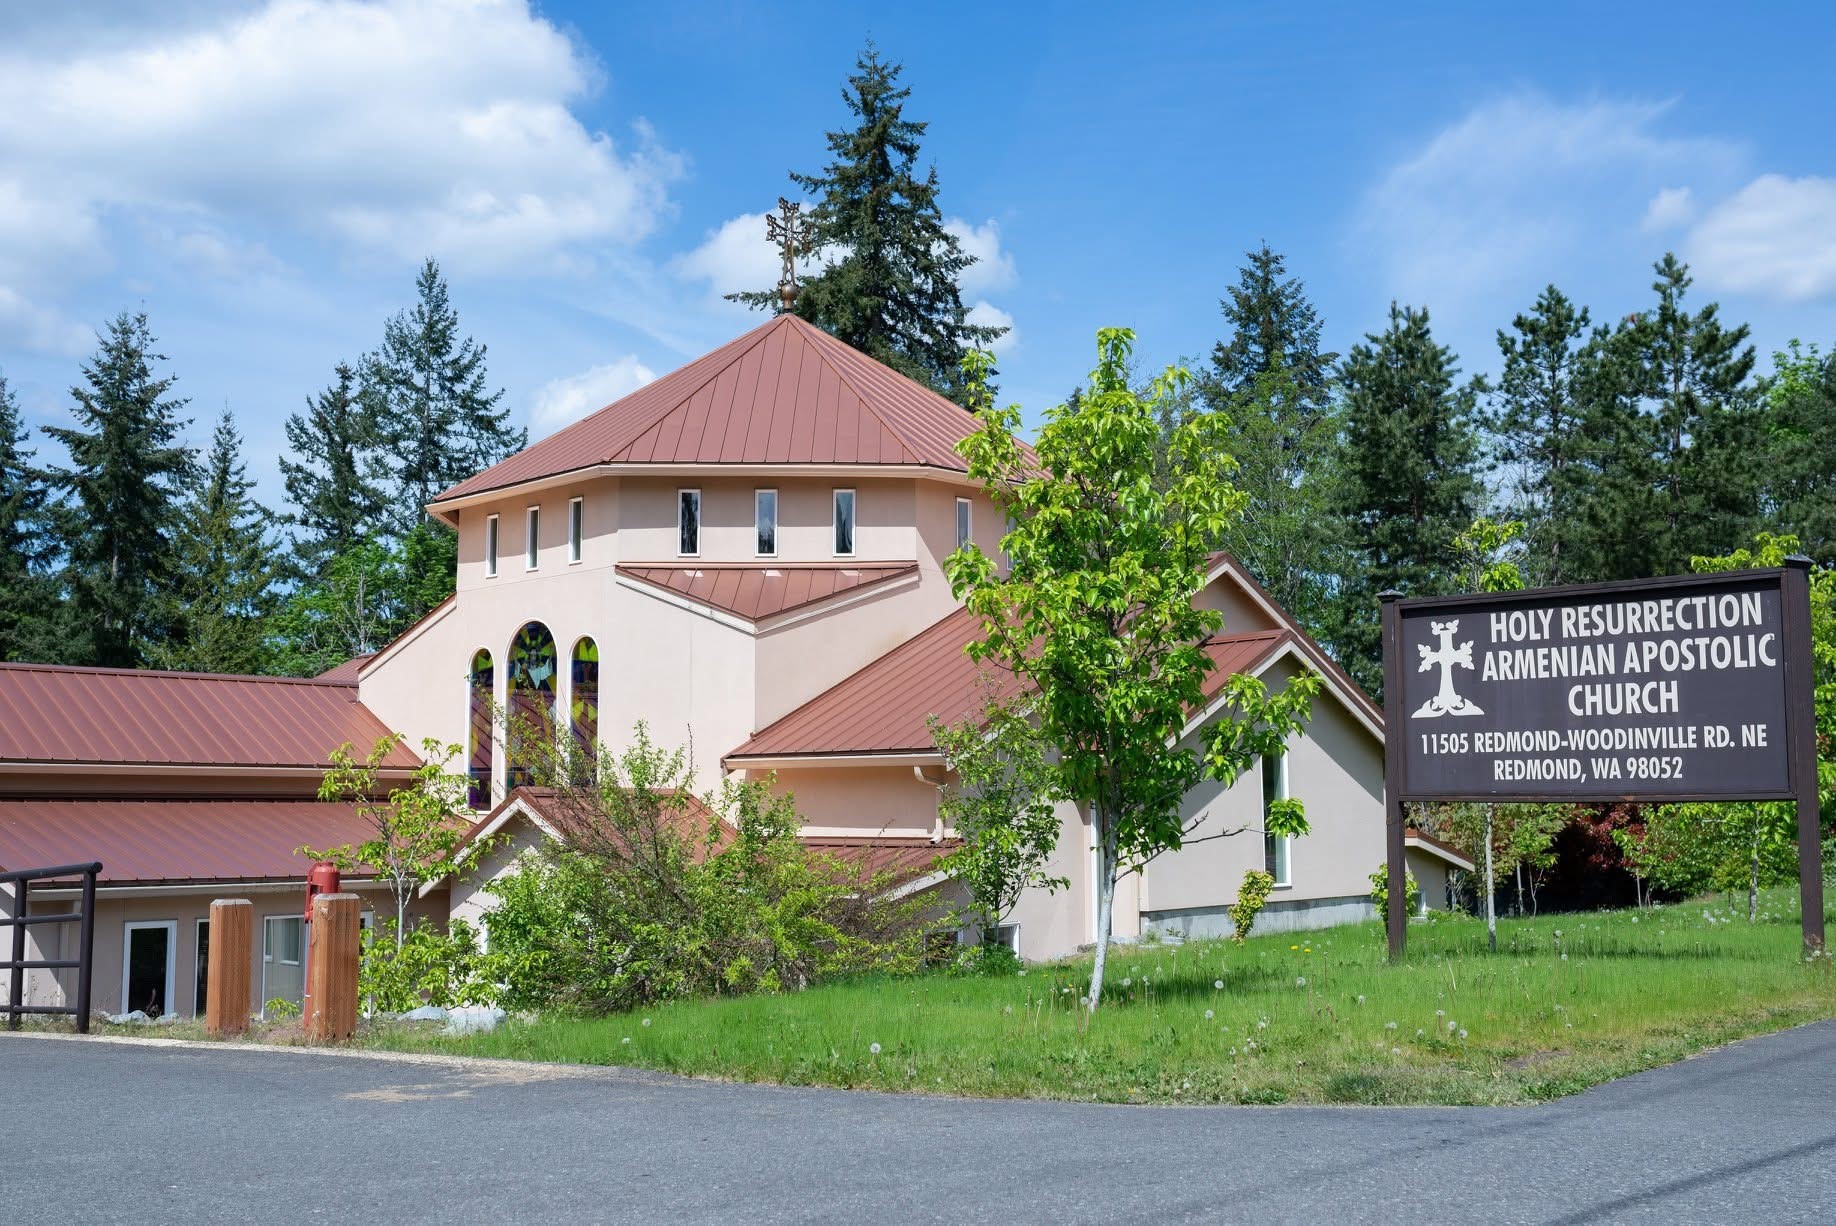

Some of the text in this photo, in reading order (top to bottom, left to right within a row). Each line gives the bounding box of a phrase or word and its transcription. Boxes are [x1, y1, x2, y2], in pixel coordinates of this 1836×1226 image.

[1490, 592, 1763, 643] HOLY RESURRECTION
[1481, 632, 1777, 682] ARMENIAN APOSTOLIC
[1567, 680, 1679, 717] CHURCH
[1421, 724, 1768, 755] 11505 REDMOND-WOODINVILLE RD. NE
[1494, 756, 1683, 784] REDMOND, WA 98052
